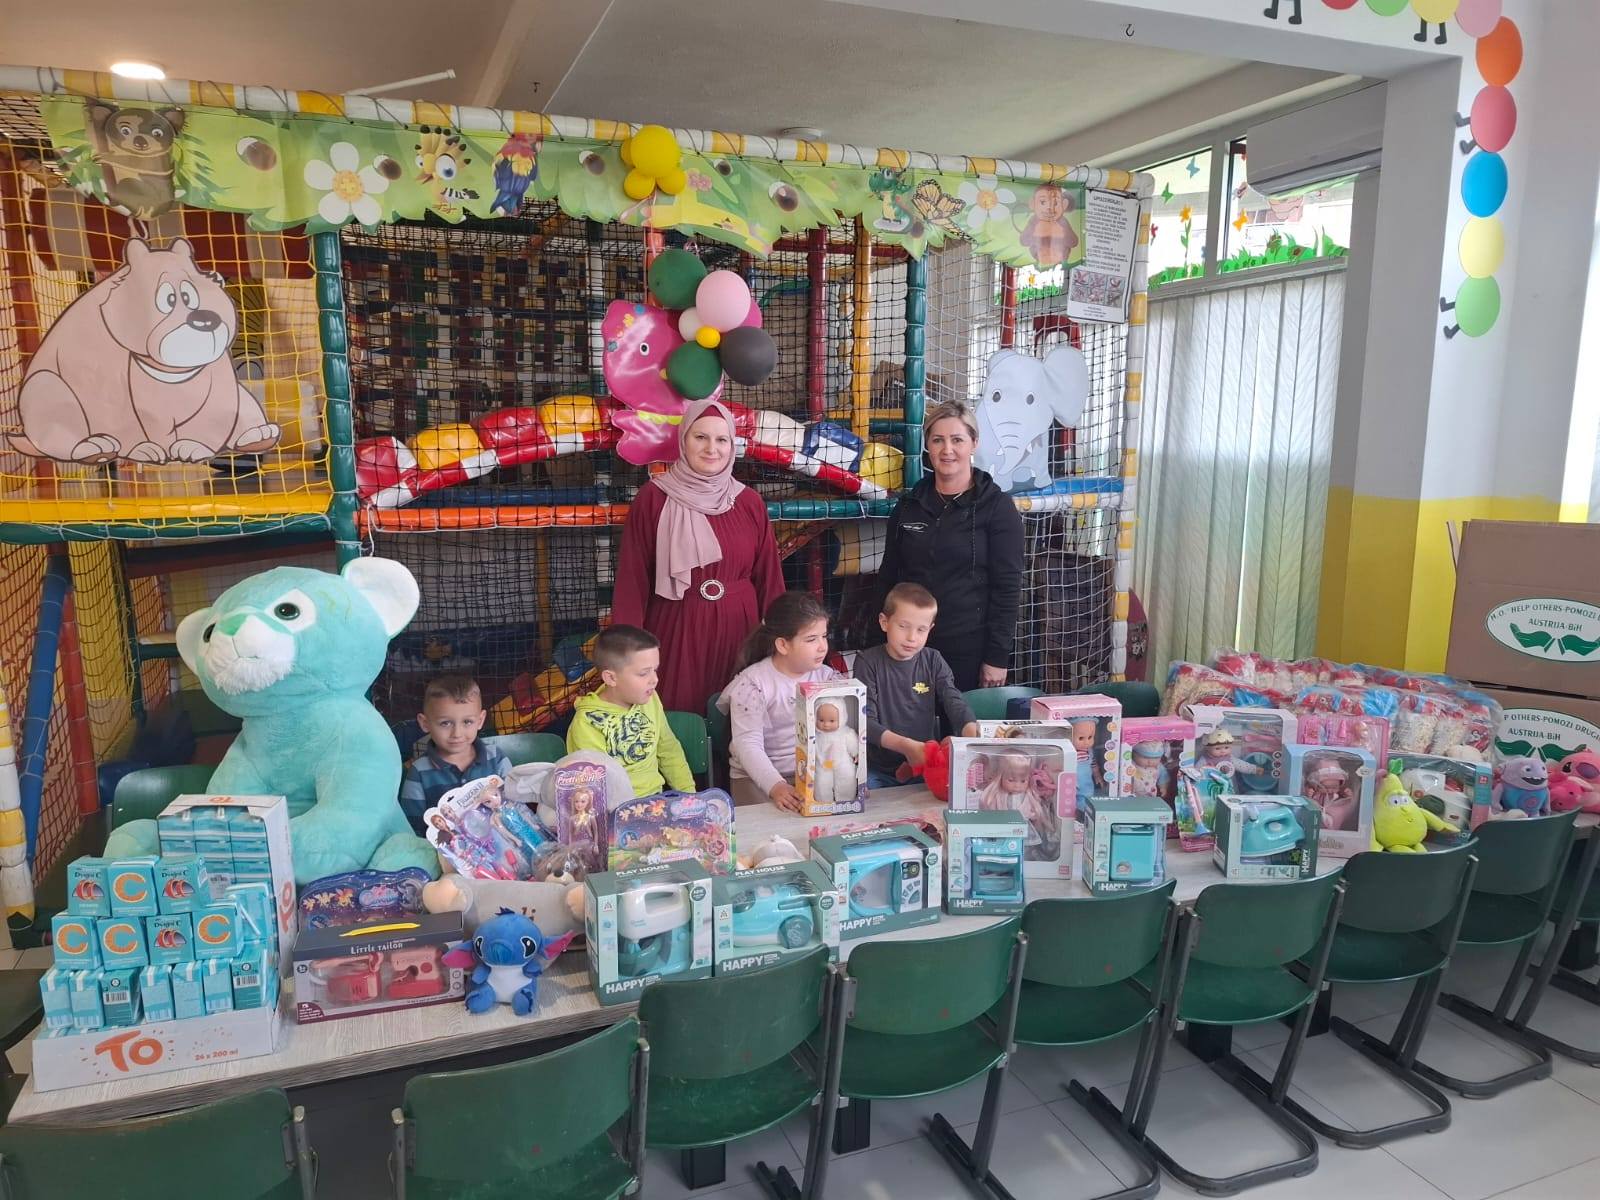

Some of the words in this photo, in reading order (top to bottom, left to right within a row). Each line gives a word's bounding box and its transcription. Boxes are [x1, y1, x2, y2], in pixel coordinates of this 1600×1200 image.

[1575, 723, 1600, 740] DRUGI
[615, 868, 638, 877] PLAY
[640, 864, 670, 873] HOUSE
[735, 869, 755, 877] PLAY
[757, 865, 787, 874] HOUSE
[113, 872, 148, 903] C
[956, 899, 984, 908] HAPPY
[197, 914, 231, 945] C
[840, 916, 873, 931] HAPPY
[56, 923, 90, 955] C
[103, 923, 138, 955] C
[722, 955, 765, 972] HAPPY
[605, 977, 646, 994] HAPPY
[94, 1029, 164, 1072] TO
[213, 1050, 228, 1058] 200
